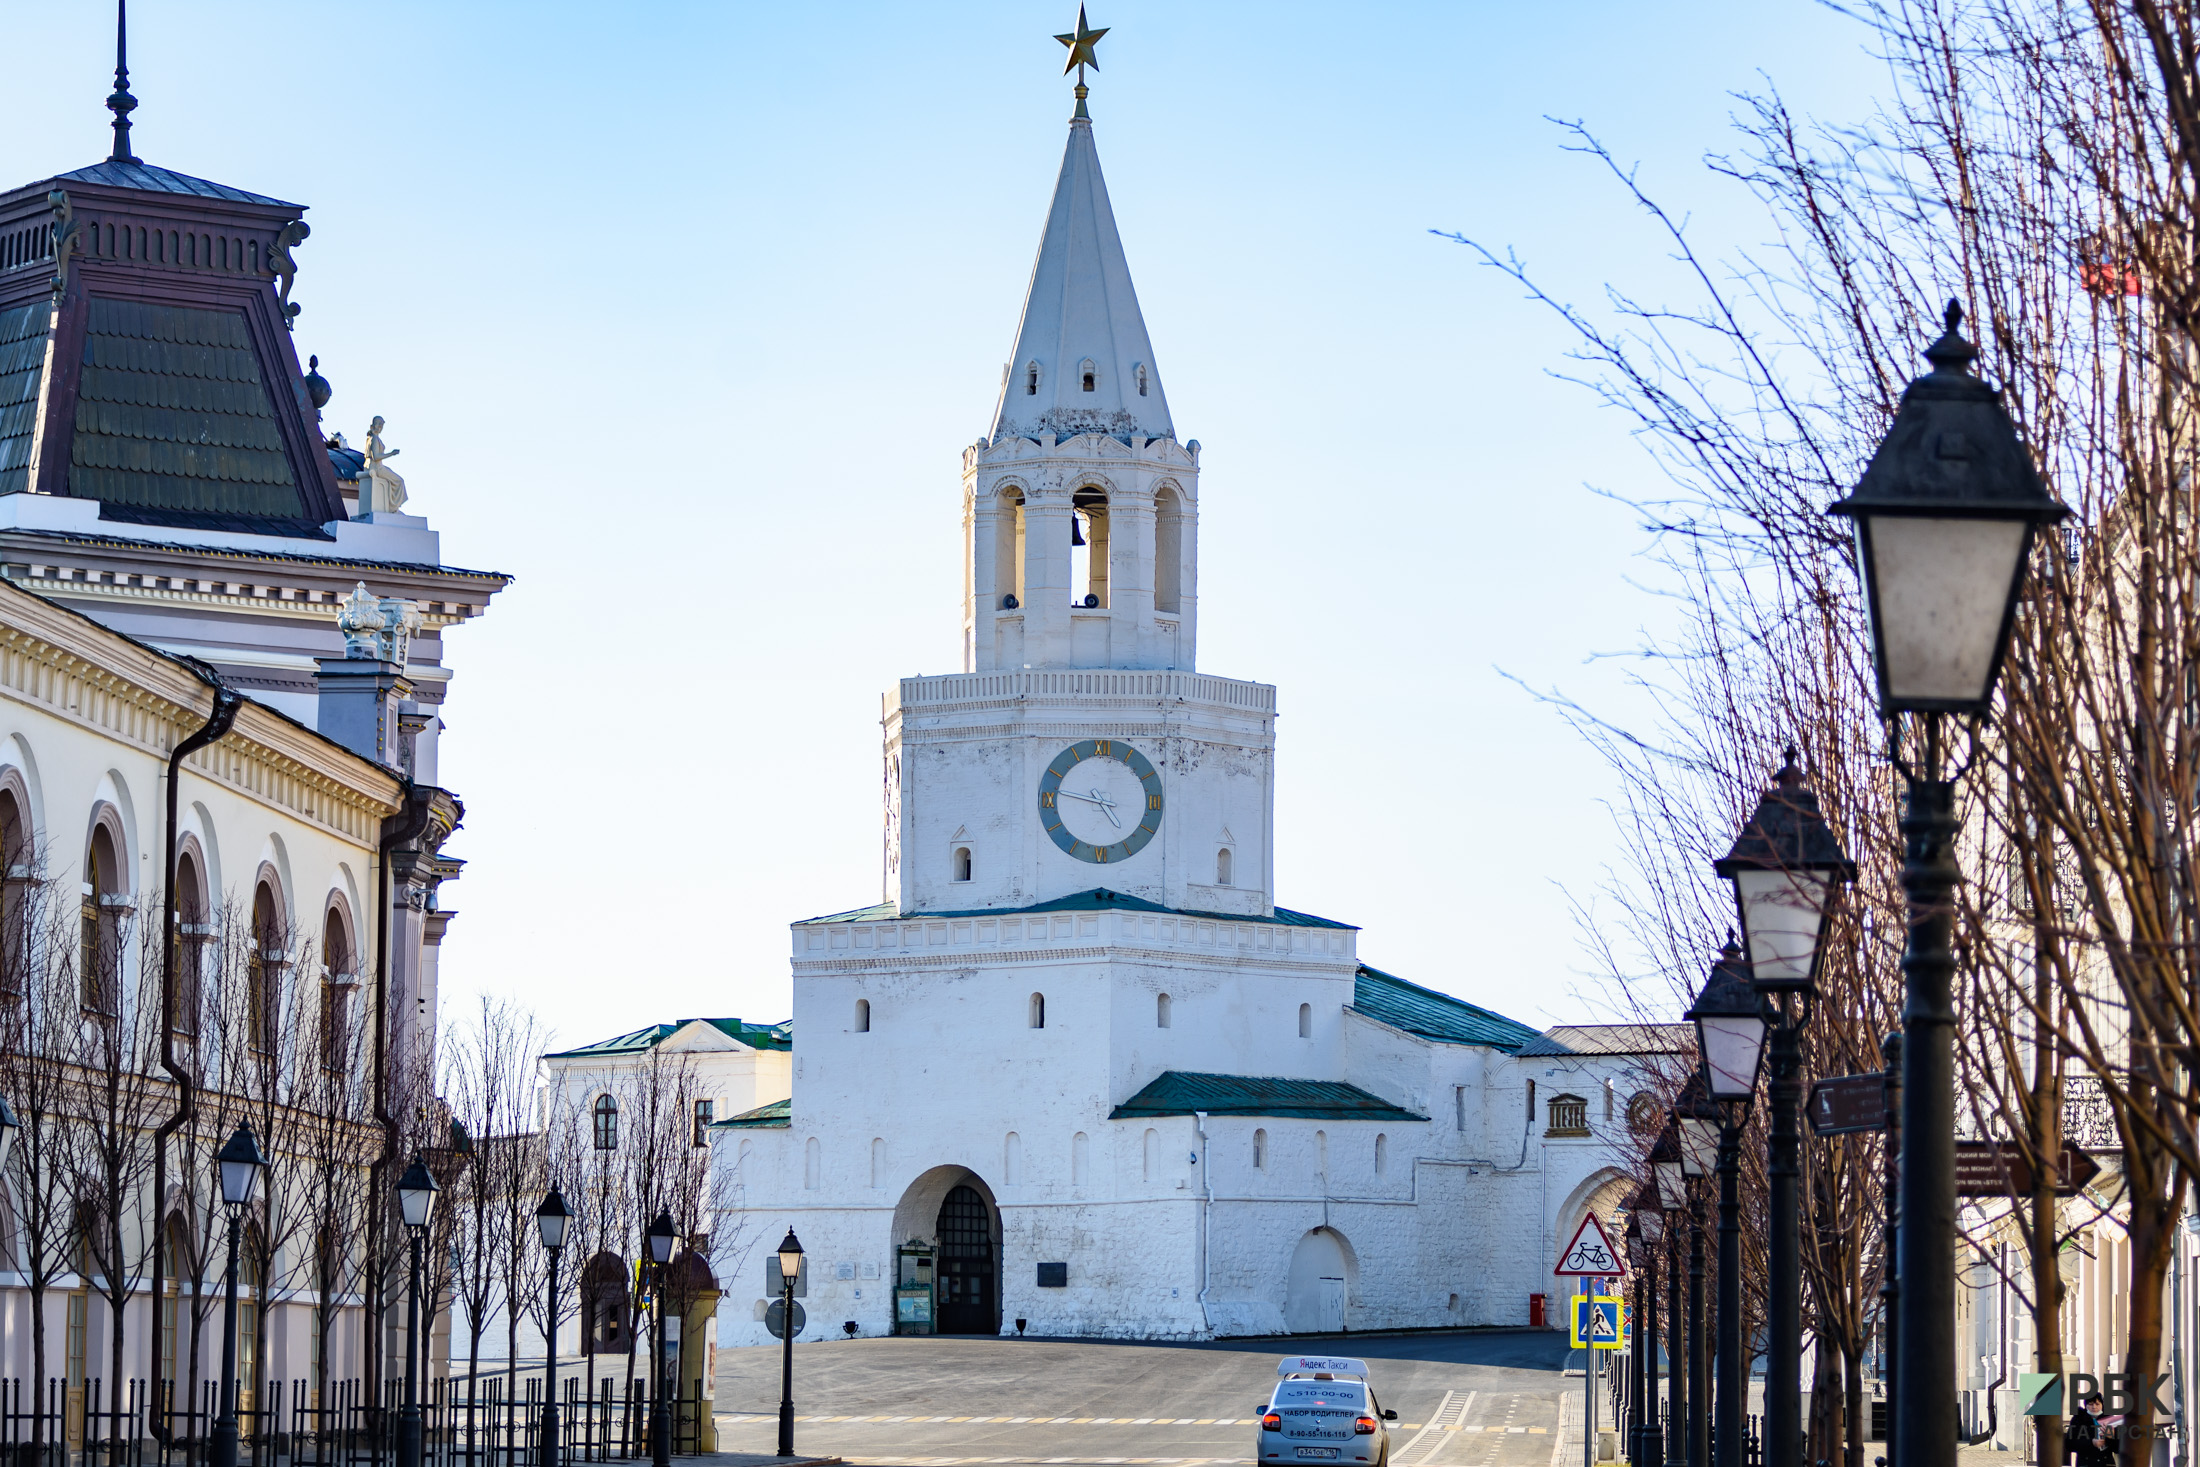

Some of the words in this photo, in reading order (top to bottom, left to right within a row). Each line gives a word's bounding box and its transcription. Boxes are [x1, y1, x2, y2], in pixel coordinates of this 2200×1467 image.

[1094, 740, 1111, 756] XII
[1042, 792, 1055, 808] IX
[1148, 794, 1161, 810] III
[1094, 846, 1107, 863] VI
[1300, 1358, 1326, 1370] Яндекс
[1328, 1359, 1348, 1370] Такси
[1296, 1390, 1354, 1399] 510-00-00
[1310, 1410, 1354, 1418] ВОДИТЕЛЕЙ
[1290, 1430, 1346, 1438] 8-90-55-116-116
